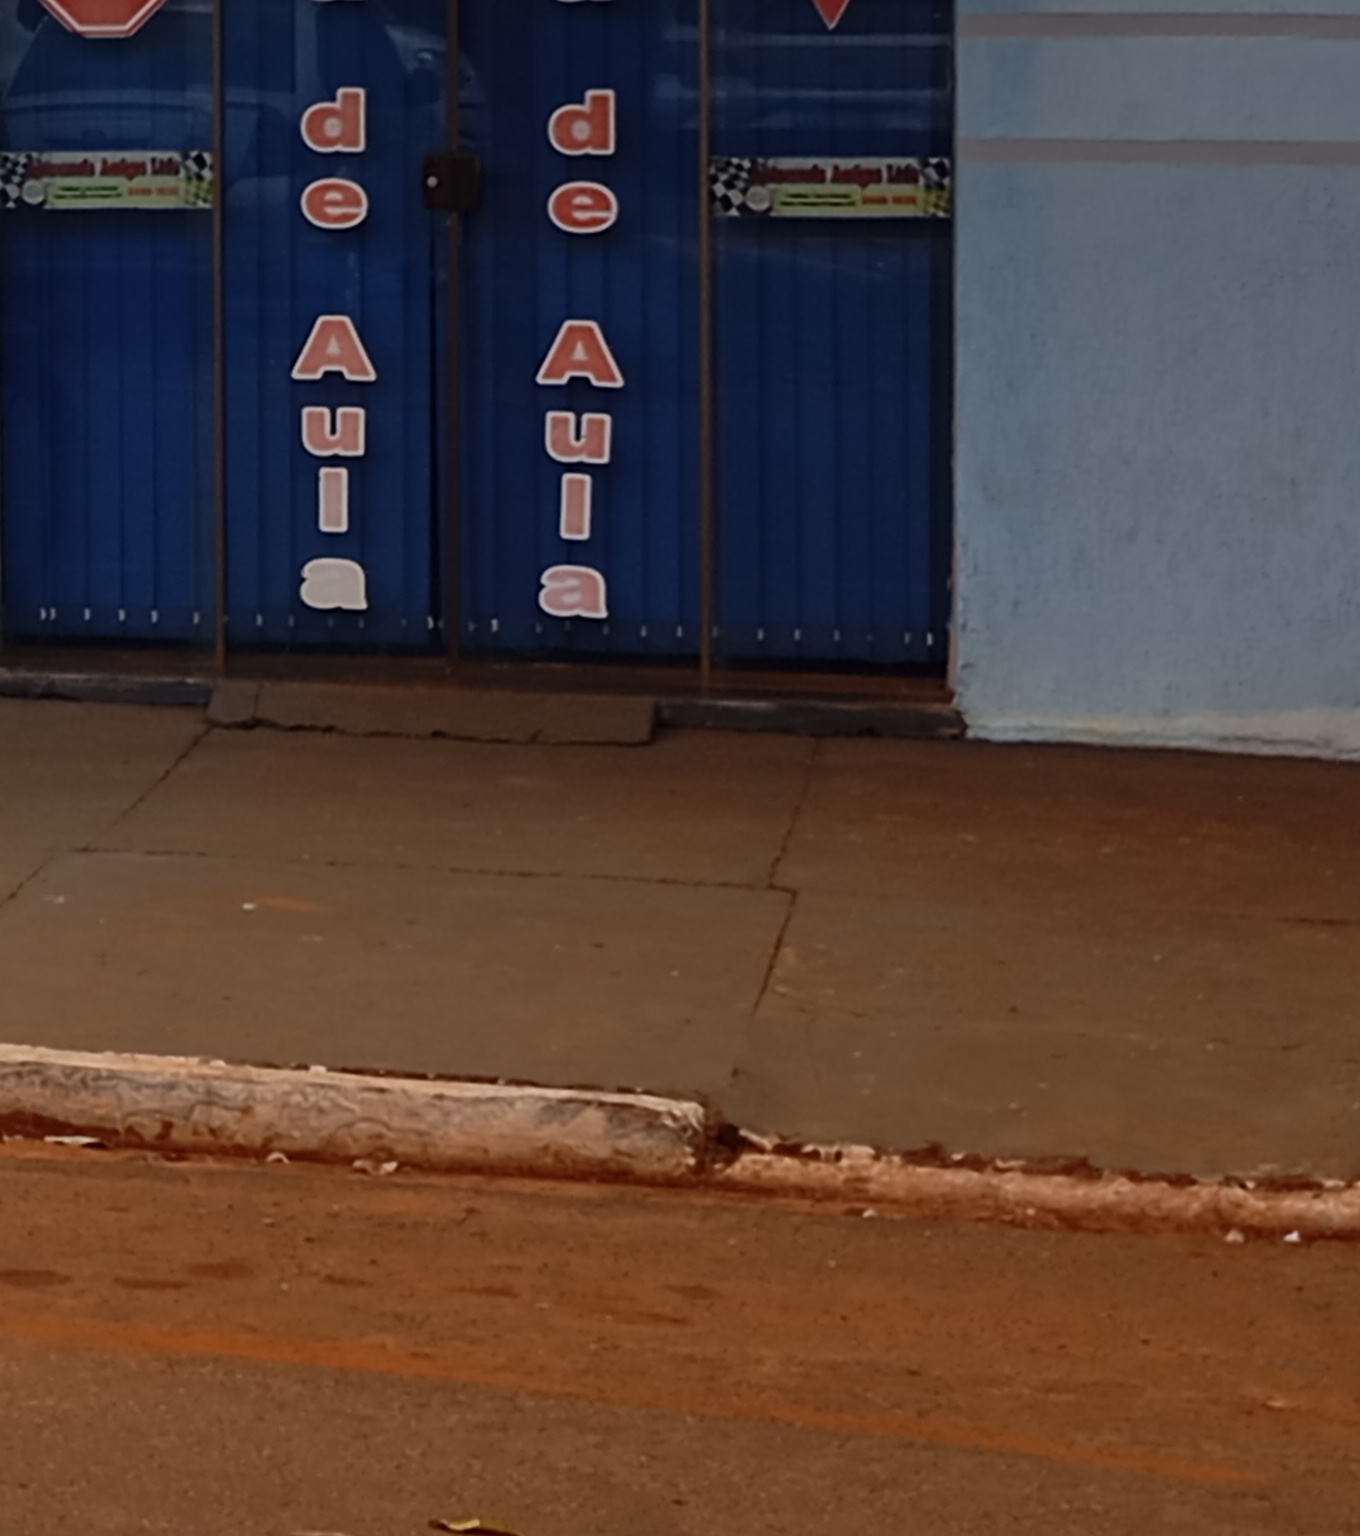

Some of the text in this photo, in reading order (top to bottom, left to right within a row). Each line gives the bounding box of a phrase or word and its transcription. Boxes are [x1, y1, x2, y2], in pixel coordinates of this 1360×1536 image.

[300, 87, 368, 229] de
[547, 88, 618, 234] de
[291, 314, 377, 610] Aula
[536, 320, 625, 619] Aula
